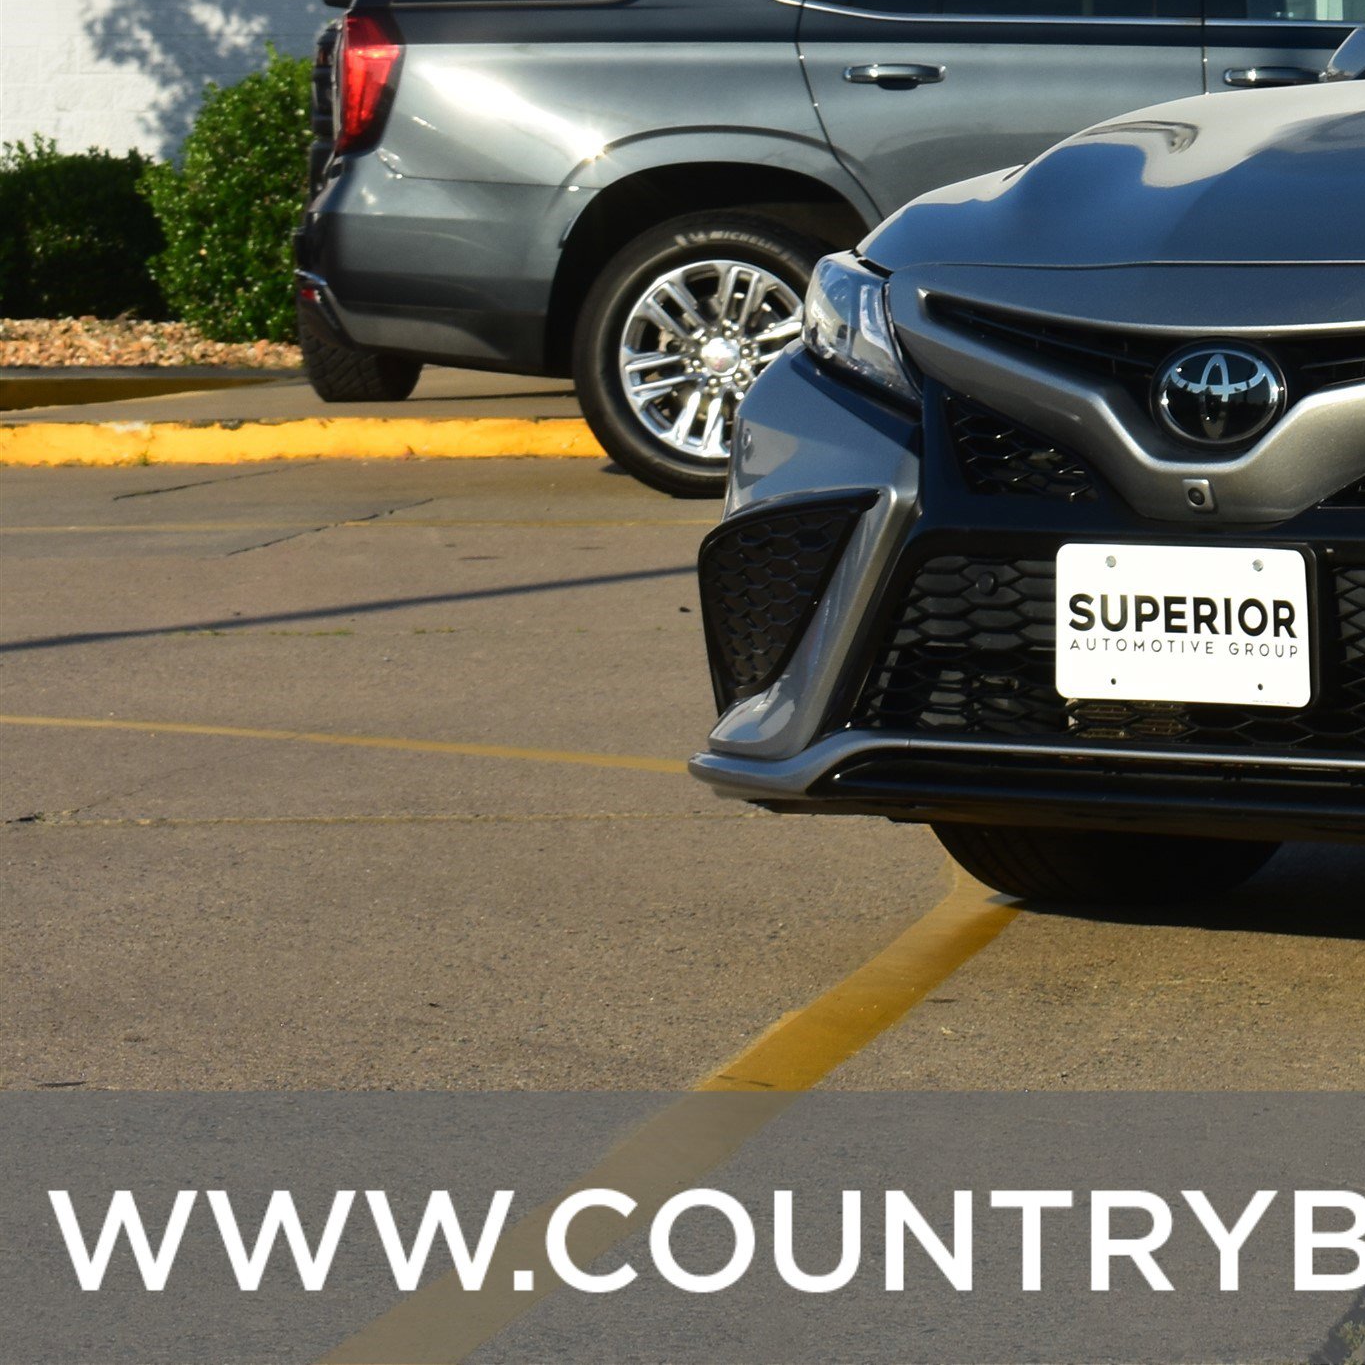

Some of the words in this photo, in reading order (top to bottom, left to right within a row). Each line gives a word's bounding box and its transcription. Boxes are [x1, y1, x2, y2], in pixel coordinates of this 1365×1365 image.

[1068, 592, 1299, 639] SUPERIOR
[1069, 637, 1215, 655] AUTOMOTIVE
[1228, 641, 1299, 659] GROUP
